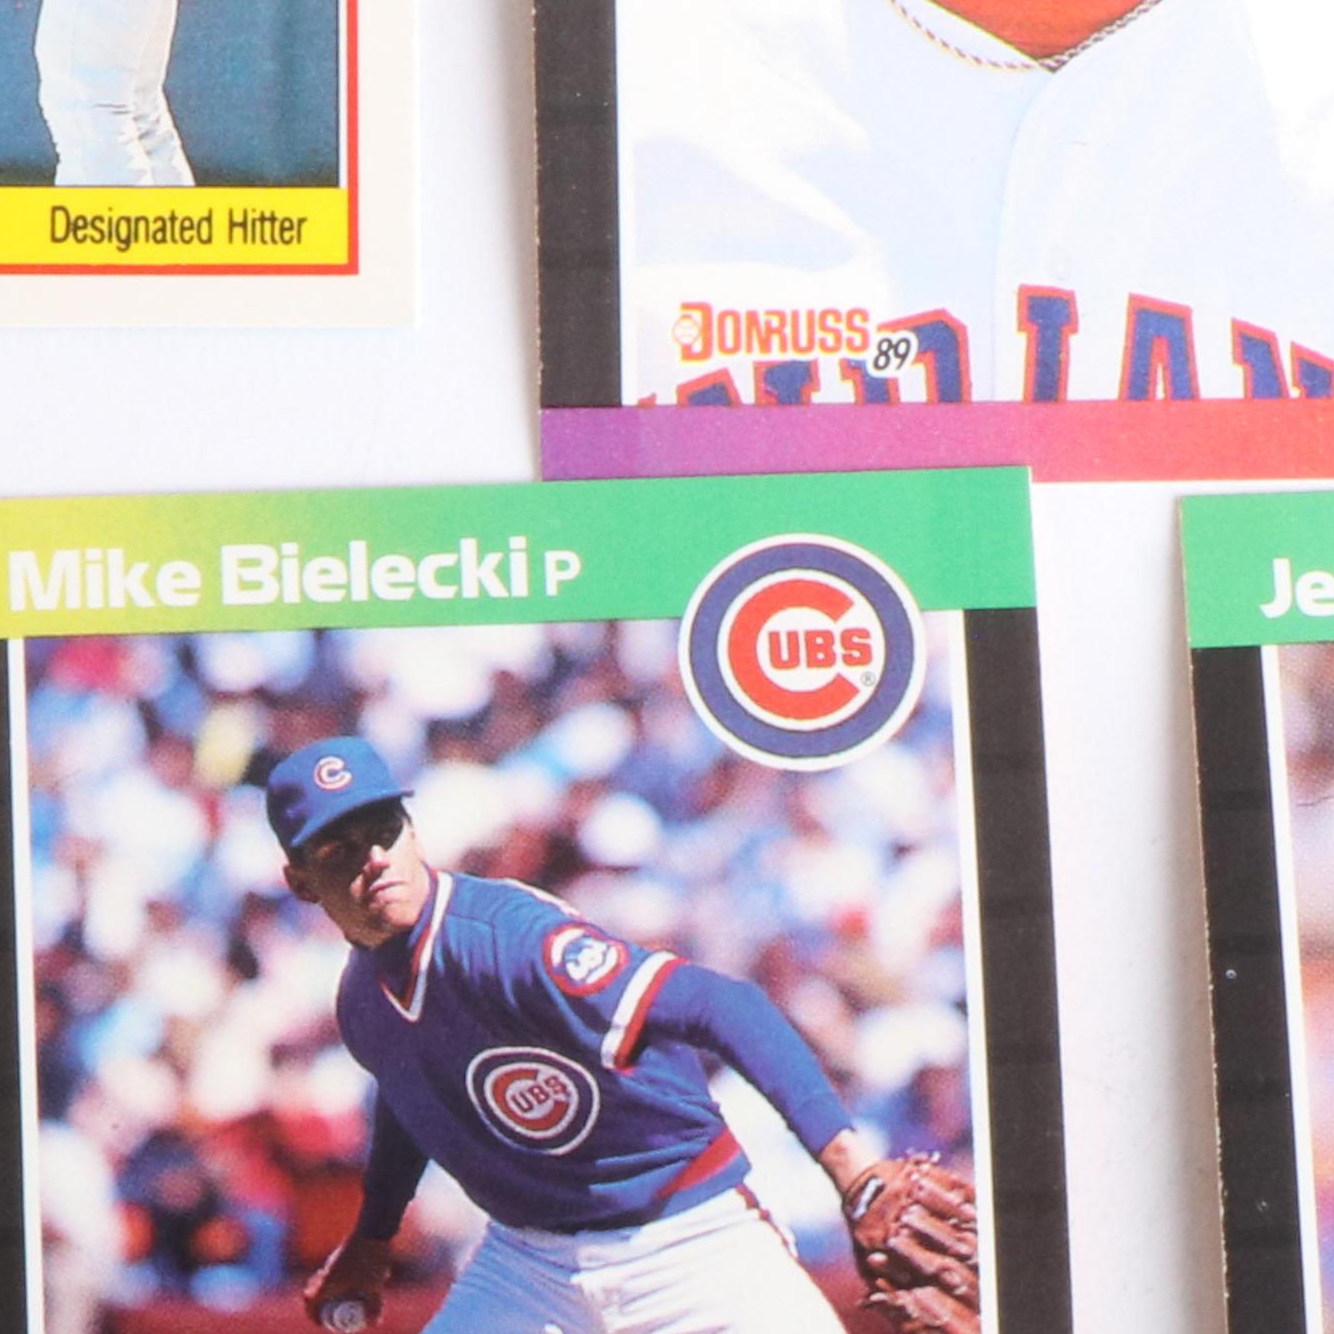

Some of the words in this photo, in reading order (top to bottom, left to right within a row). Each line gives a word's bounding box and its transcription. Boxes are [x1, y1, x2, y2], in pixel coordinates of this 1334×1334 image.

[50, 205, 214, 254] Designated
[227, 207, 307, 246] Hitter
[672, 301, 871, 362] DONRUSS
[872, 337, 912, 371] 89
[8, 548, 202, 611] Mike
[220, 536, 529, 606] Bielecki
[544, 549, 582, 597] P
